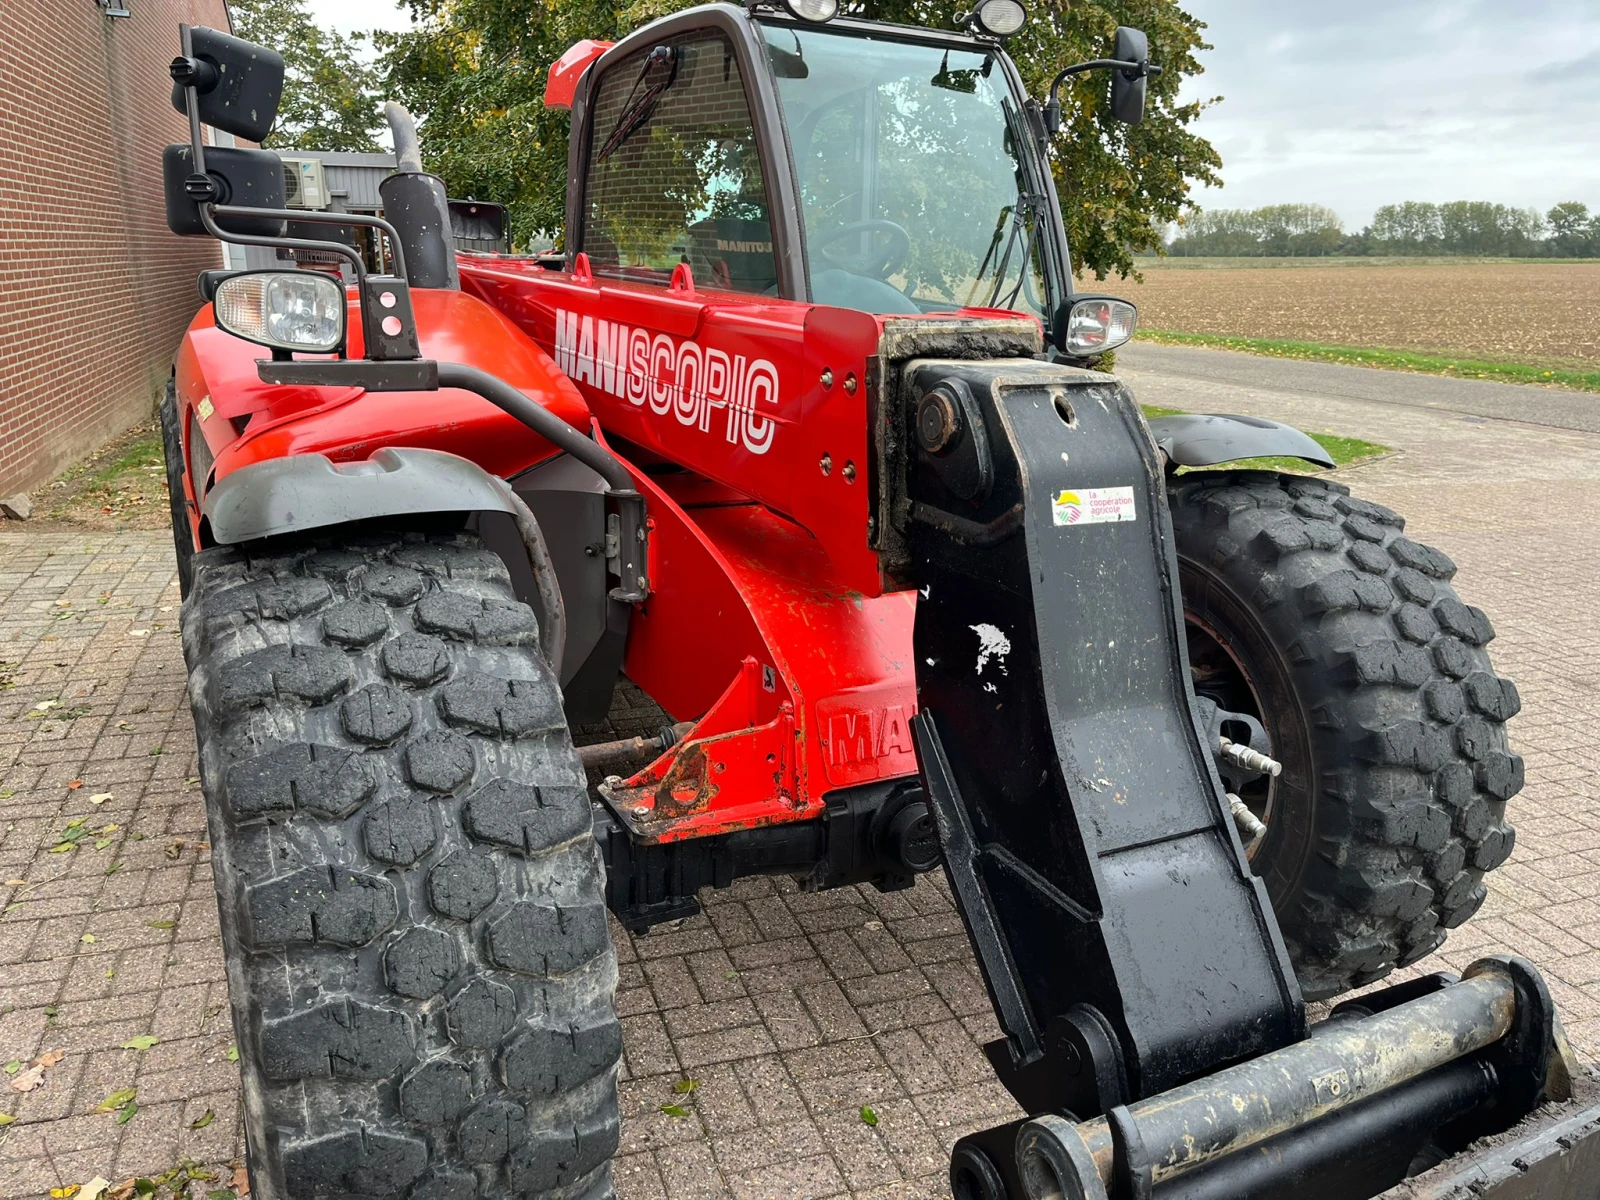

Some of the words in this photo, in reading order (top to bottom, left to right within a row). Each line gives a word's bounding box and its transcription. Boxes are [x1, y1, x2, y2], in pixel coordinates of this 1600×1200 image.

[554, 307, 779, 455] MANISCOPIC
[1089, 490, 1097, 499] la
[1089, 497, 1133, 507] coopération
[1090, 505, 1121, 516] agricole
[828, 704, 917, 766] MA
